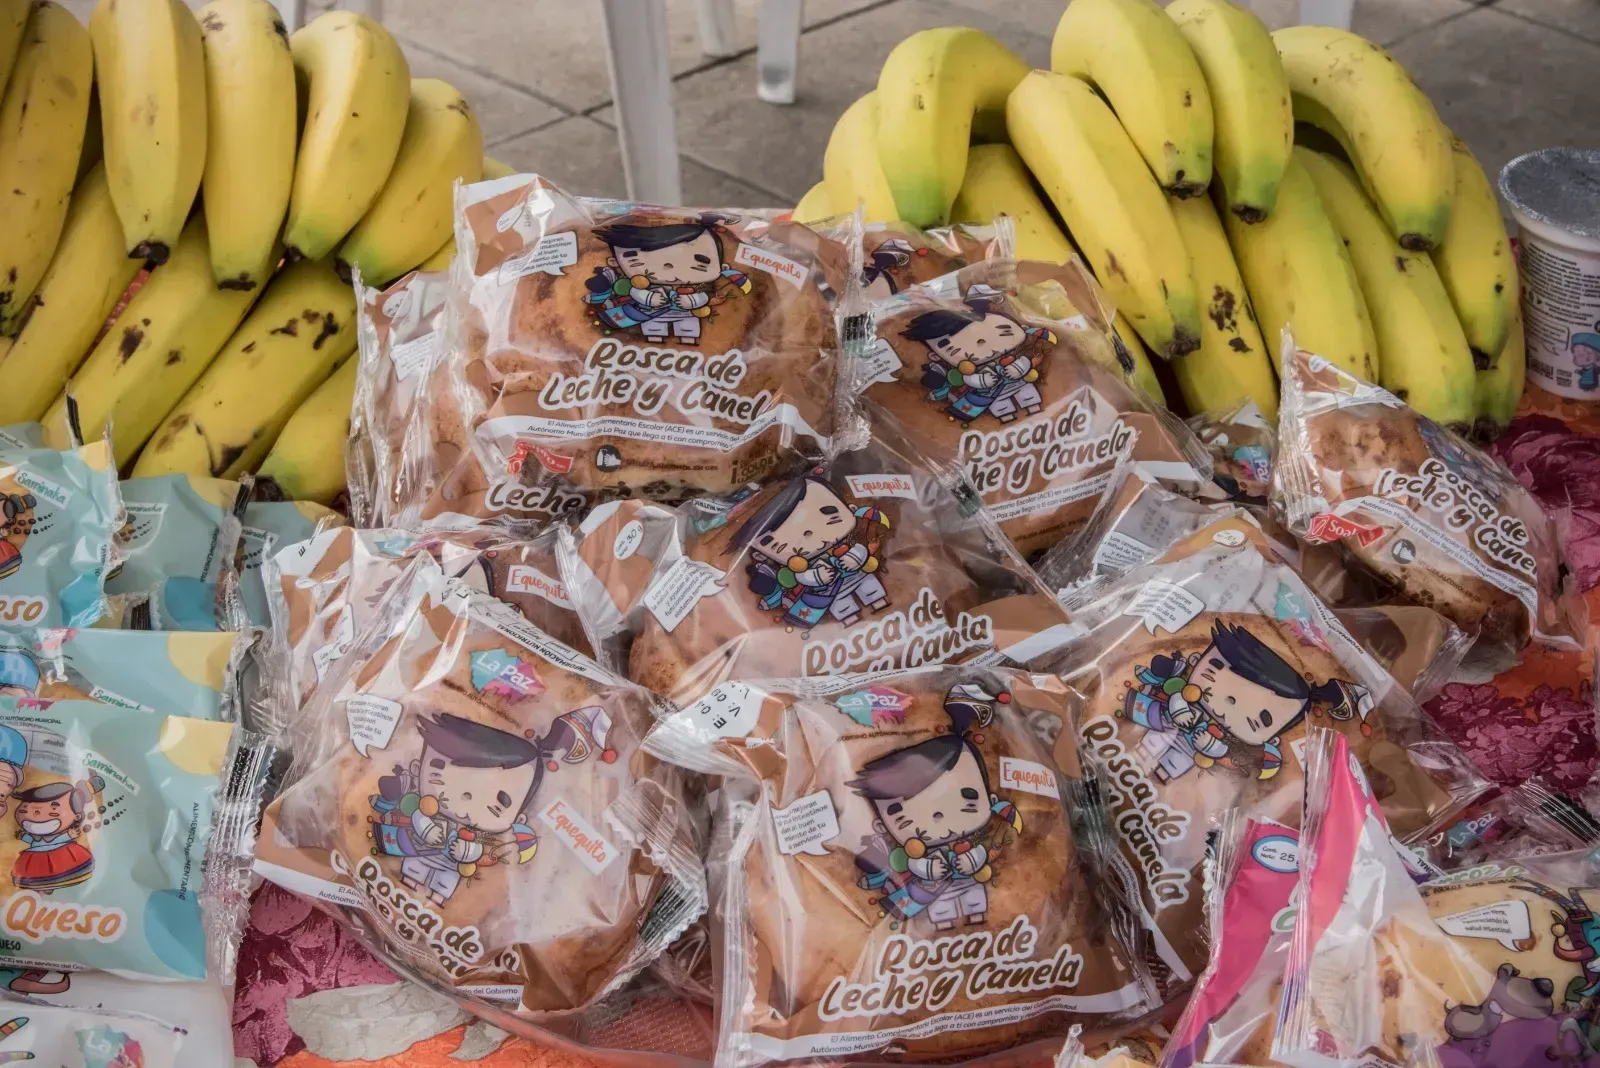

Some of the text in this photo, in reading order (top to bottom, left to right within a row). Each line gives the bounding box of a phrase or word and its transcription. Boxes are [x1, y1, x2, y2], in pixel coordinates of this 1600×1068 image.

[741, 247, 802, 280] Equequito
[588, 341, 743, 385] Rosca de
[541, 368, 768, 422] Leche y Canel
[527, 425, 565, 436] Autónomo
[613, 427, 627, 435] Paz
[627, 428, 641, 438] que
[642, 429, 660, 441] llega
[555, 420, 586, 429] Alimento
[638, 421, 664, 431] Escolar
[664, 423, 685, 434] (ACE)
[705, 430, 728, 442] servicio
[964, 404, 1088, 466] Rosca de
[1011, 456, 1032, 489] y
[1042, 423, 1132, 476] Canela
[1255, 459, 1271, 482] Paz
[489, 478, 583, 514] Leche
[996, 510, 1008, 519] Paz
[1008, 510, 1021, 518] que
[1021, 504, 1036, 514] llega
[1059, 488, 1094, 504] compromiso
[1016, 496, 1037, 507] Escolar
[1037, 491, 1054, 501] (ACE)
[1071, 481, 1093, 493] servicio
[1378, 470, 1451, 507] Leche
[1447, 508, 1473, 528] y
[1423, 461, 1527, 542] Rosca de
[1360, 499, 1393, 515] Autónomo
[1410, 523, 1419, 532] La
[1419, 529, 1429, 539] Paz
[1429, 535, 1440, 546] que
[1440, 540, 1455, 556] llega
[1440, 533, 1461, 548] Escolar
[496, 624, 545, 654] NUTRICIONAL
[805, 590, 945, 677] Rosca de
[476, 652, 537, 688] La Paz
[546, 649, 588, 672] INFORMACIÓN
[840, 693, 901, 707] La Paz
[1003, 761, 1055, 791] Equequito
[1082, 720, 1187, 840] Rosca de
[546, 799, 607, 864] Equequito
[807, 826, 817, 834] de
[1465, 812, 1497, 834] Paz
[1118, 814, 1187, 902] Canela
[1279, 852, 1296, 863] 25
[5, 895, 122, 940] Queso
[358, 860, 439, 935] Rosca
[444, 930, 480, 959] de
[879, 920, 1031, 976] Rosca de
[485, 987, 519, 996] Gobierno
[822, 948, 1081, 1016] Leche y Canela
[810, 1045, 852, 1054] Autónomo
[922, 1029, 934, 1037] que
[933, 1022, 949, 1033] llega
[955, 1021, 962, 1029] ti
[963, 1021, 976, 1029] con
[977, 1014, 1019, 1028] compromiso
[830, 1035, 839, 1043] El
[839, 1033, 875, 1043] Alimento
[930, 1013, 953, 1025] Escolar
[953, 1012, 975, 1022] (ACE)
[993, 1006, 1021, 1016] servicio
[1021, 1003, 1033, 1012] del
